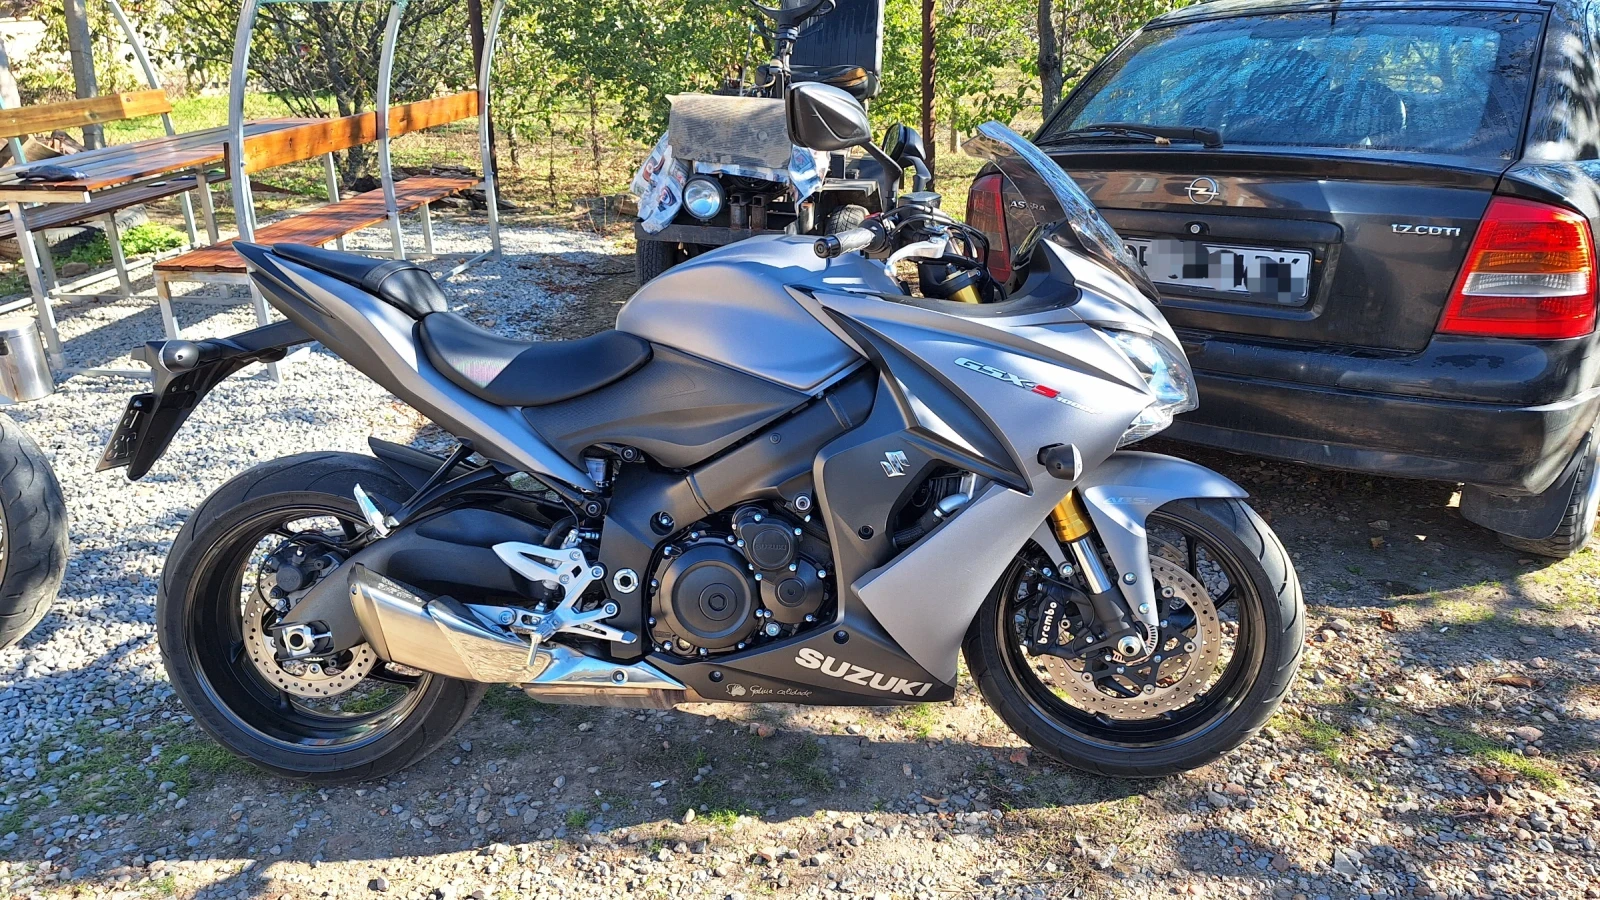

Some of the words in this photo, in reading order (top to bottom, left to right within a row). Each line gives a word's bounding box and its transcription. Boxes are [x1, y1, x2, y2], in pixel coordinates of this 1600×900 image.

[1415, 225, 1461, 237] CDTI
[954, 357, 1061, 398] GSX-S
[1037, 601, 1058, 644] brembo
[795, 647, 933, 697] SUZUKI
